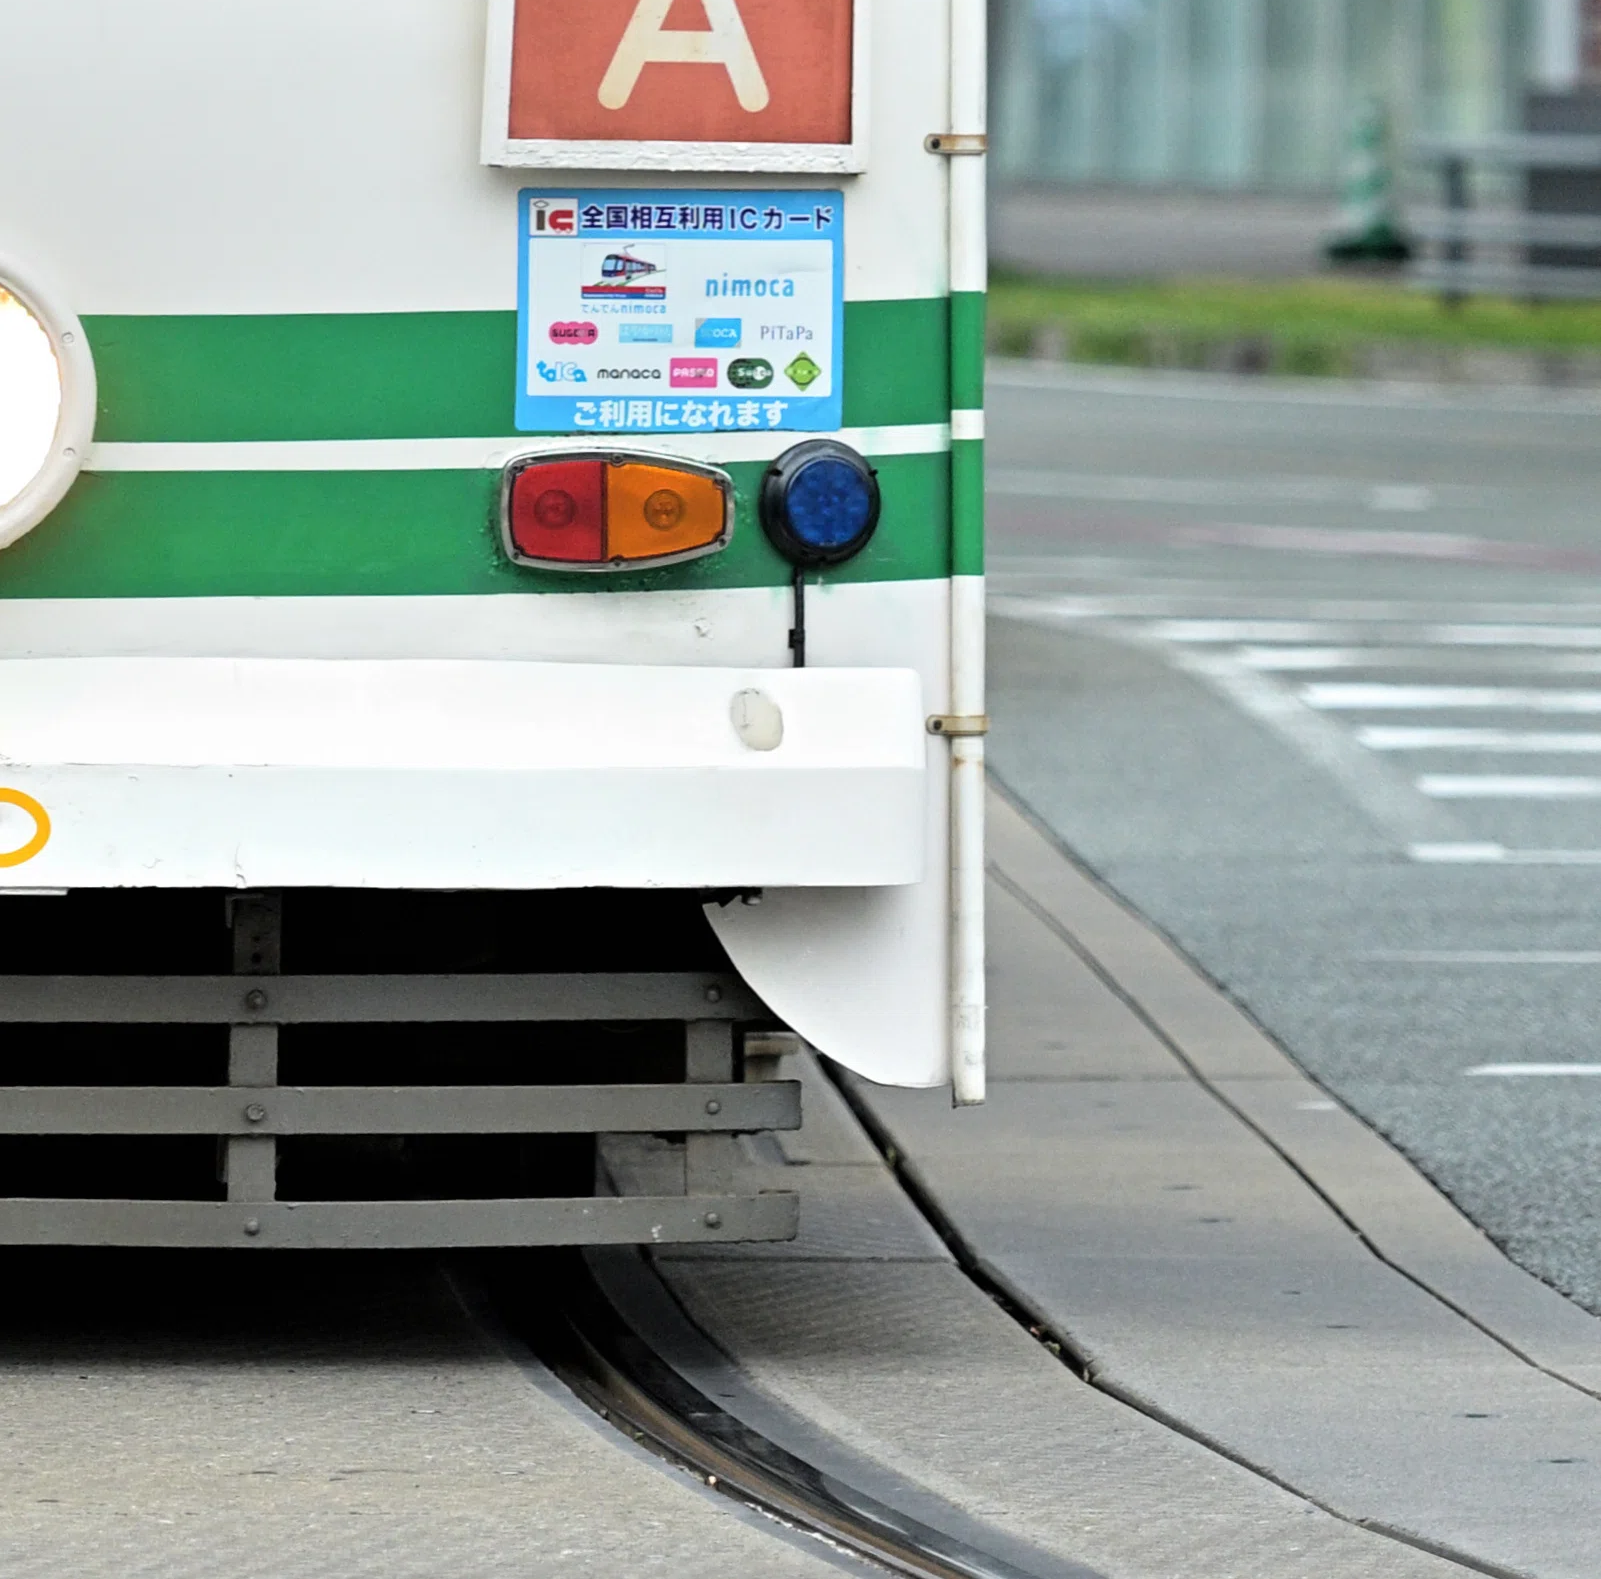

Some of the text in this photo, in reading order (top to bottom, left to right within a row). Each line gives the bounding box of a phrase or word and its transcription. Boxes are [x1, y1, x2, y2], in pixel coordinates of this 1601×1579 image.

[582, 203, 832, 232] 全国相互利用ICカード
[705, 273, 795, 297] nimoca
[552, 328, 596, 338] SUGA
[760, 325, 813, 341] PiTaPa
[596, 368, 662, 380] manaca
[573, 400, 788, 428] ご利用になれます
